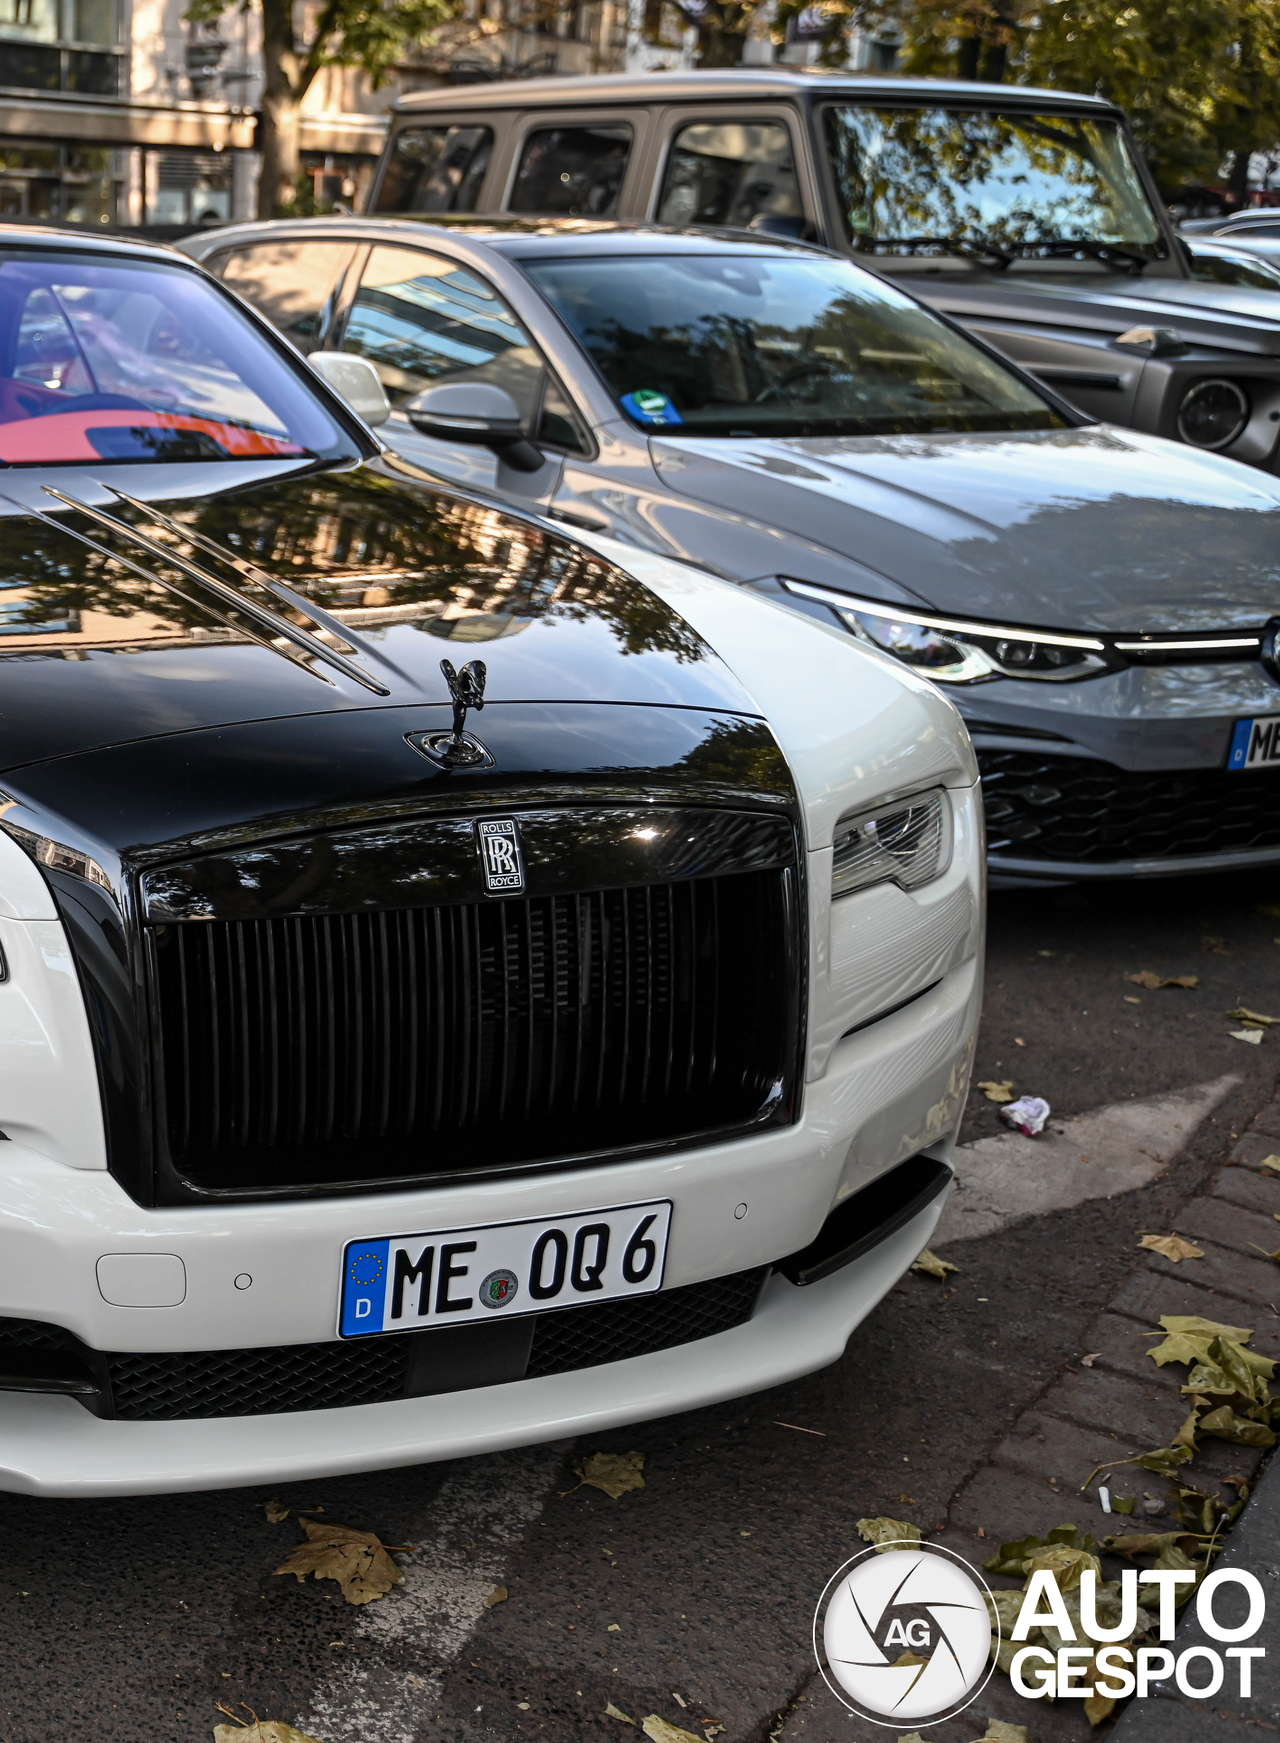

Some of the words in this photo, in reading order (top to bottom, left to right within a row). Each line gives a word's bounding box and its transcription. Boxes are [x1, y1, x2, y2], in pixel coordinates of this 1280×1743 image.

[1234, 748, 1243, 762] D
[482, 823, 512, 834] ROLLS
[490, 875, 520, 887] ROYCE
[355, 1298, 372, 1319] D
[390, 1240, 477, 1319] ME
